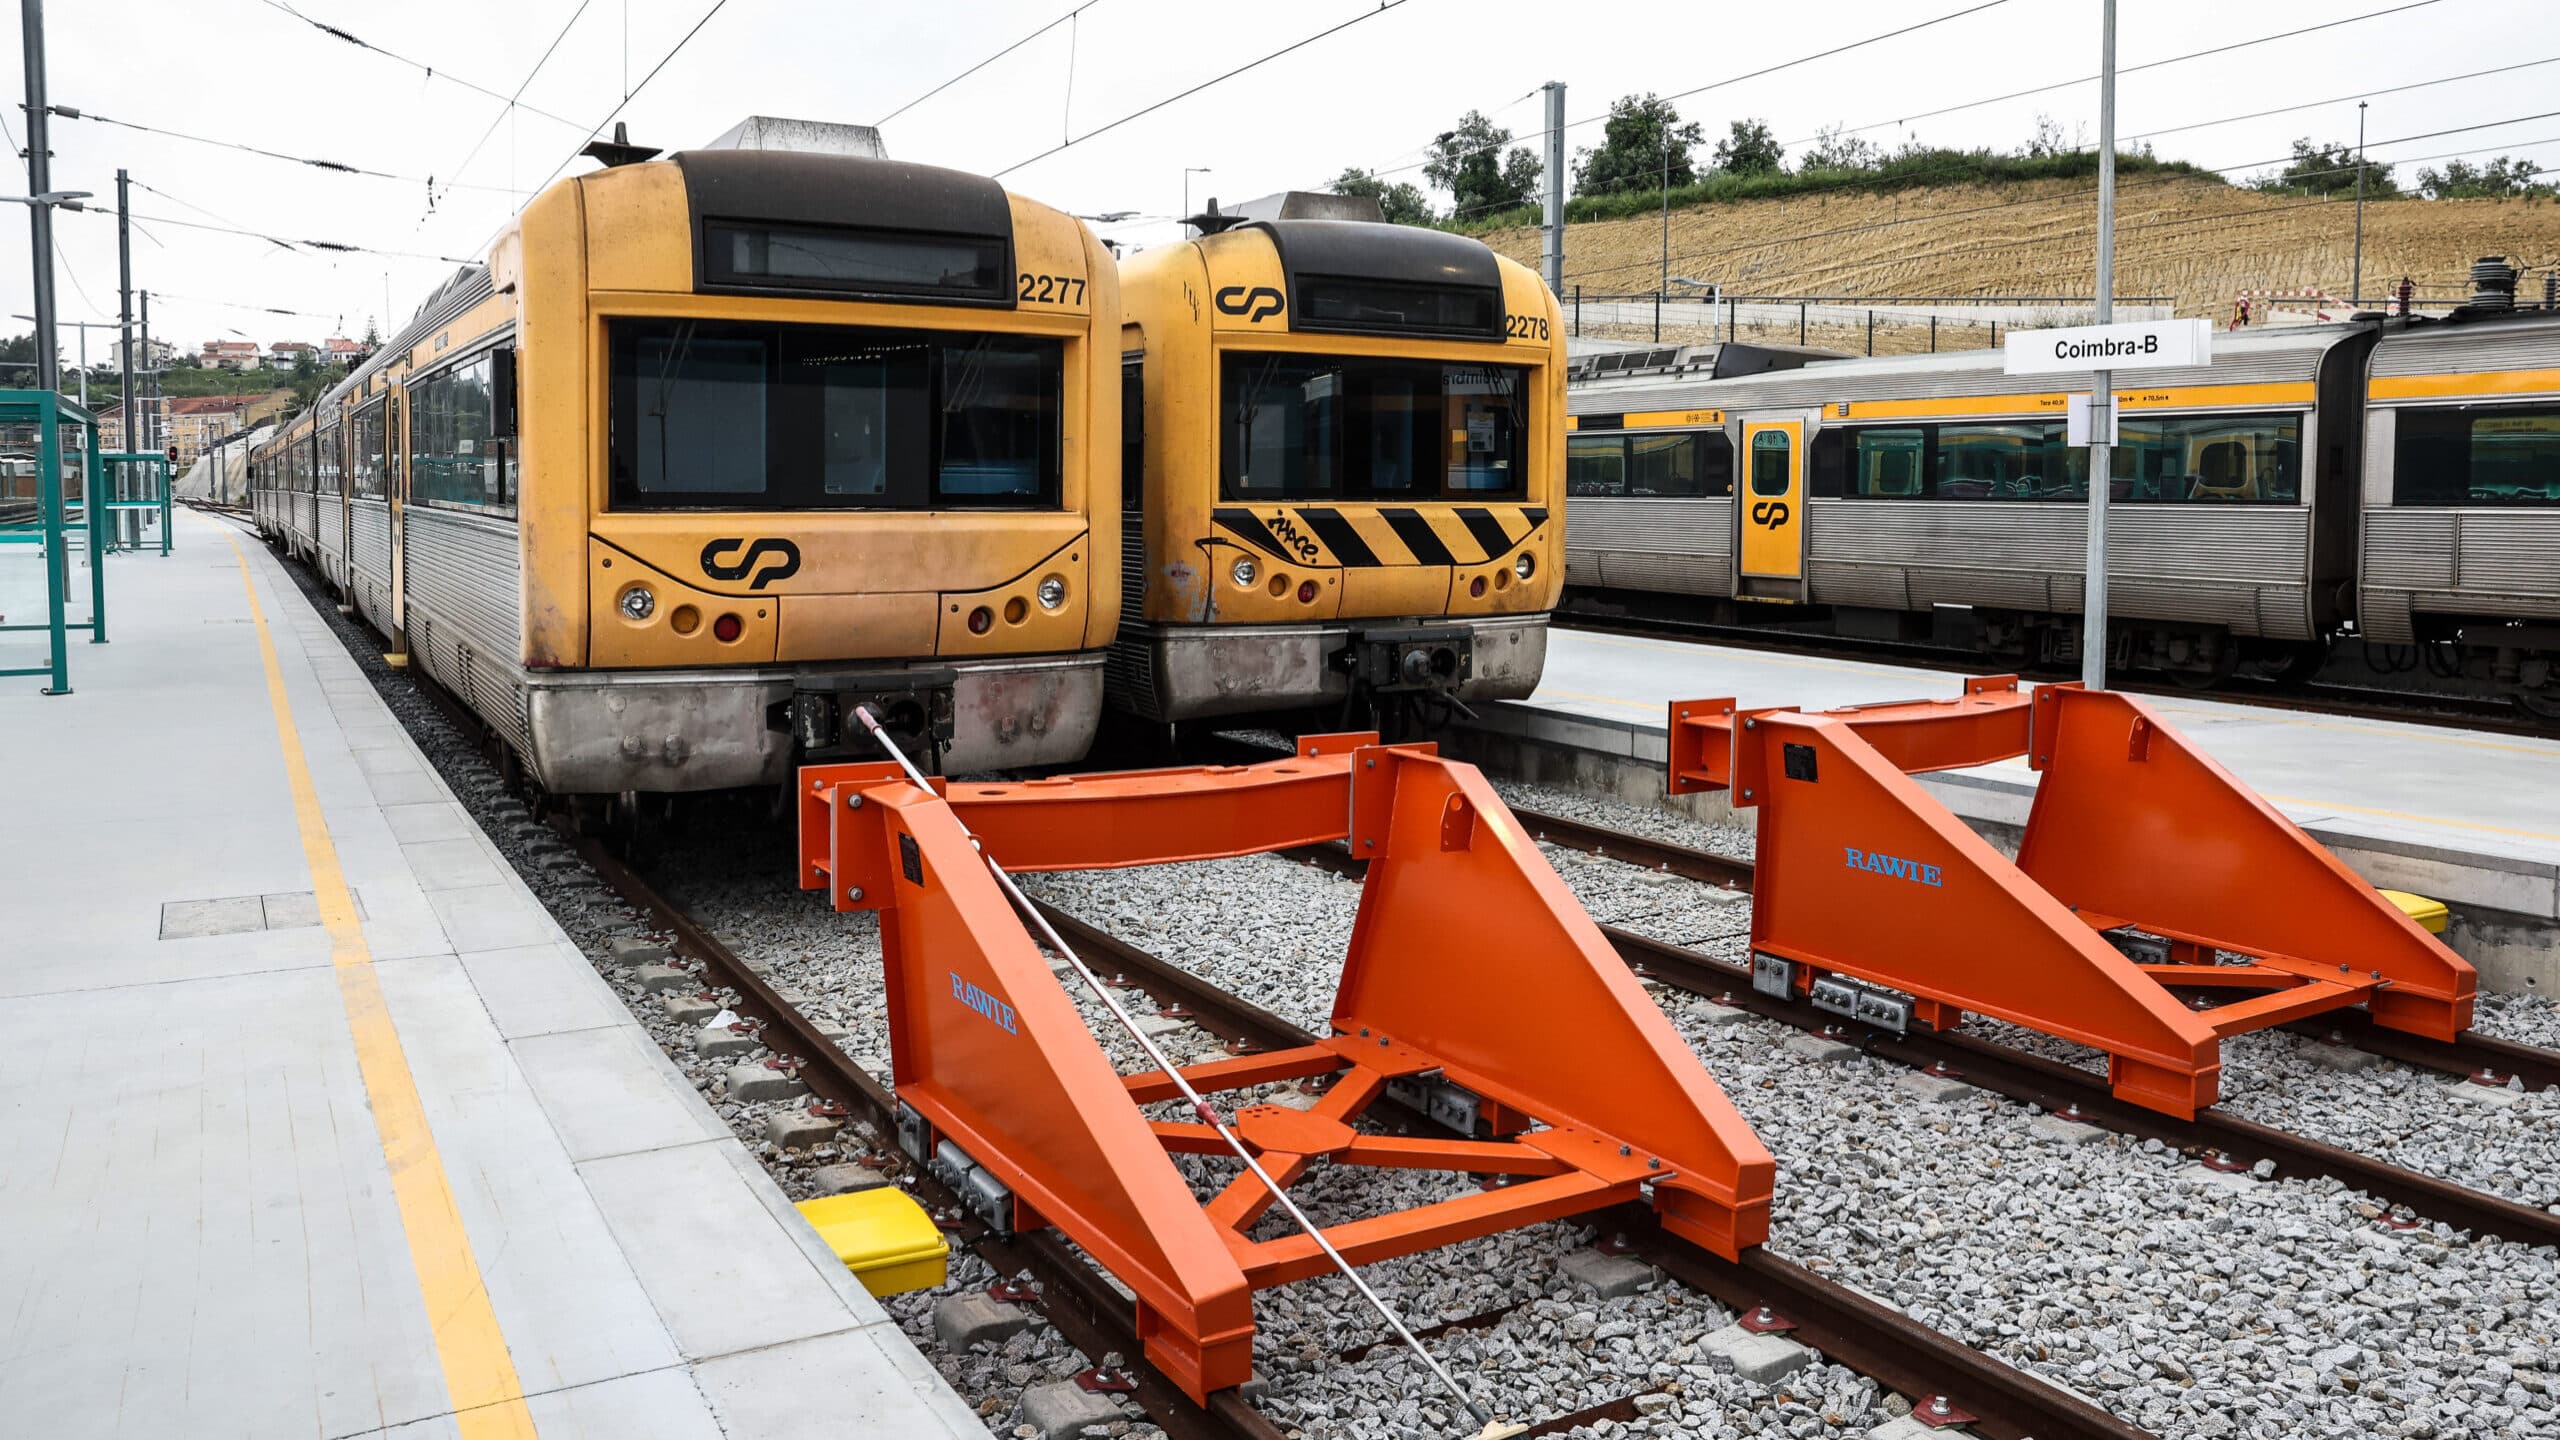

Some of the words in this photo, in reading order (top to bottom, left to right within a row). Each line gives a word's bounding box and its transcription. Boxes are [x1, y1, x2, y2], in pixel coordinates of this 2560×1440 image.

[1019, 273, 1086, 306] 2277
[1215, 286, 1285, 323] CP
[1506, 314, 1549, 341] 2278
[2055, 334, 2159, 359] Coimbra-B
[1752, 502, 1790, 530] CP
[700, 538, 801, 590] CP
[1844, 847, 1942, 887] RAWIE
[950, 972, 1017, 1035] RAWIE
